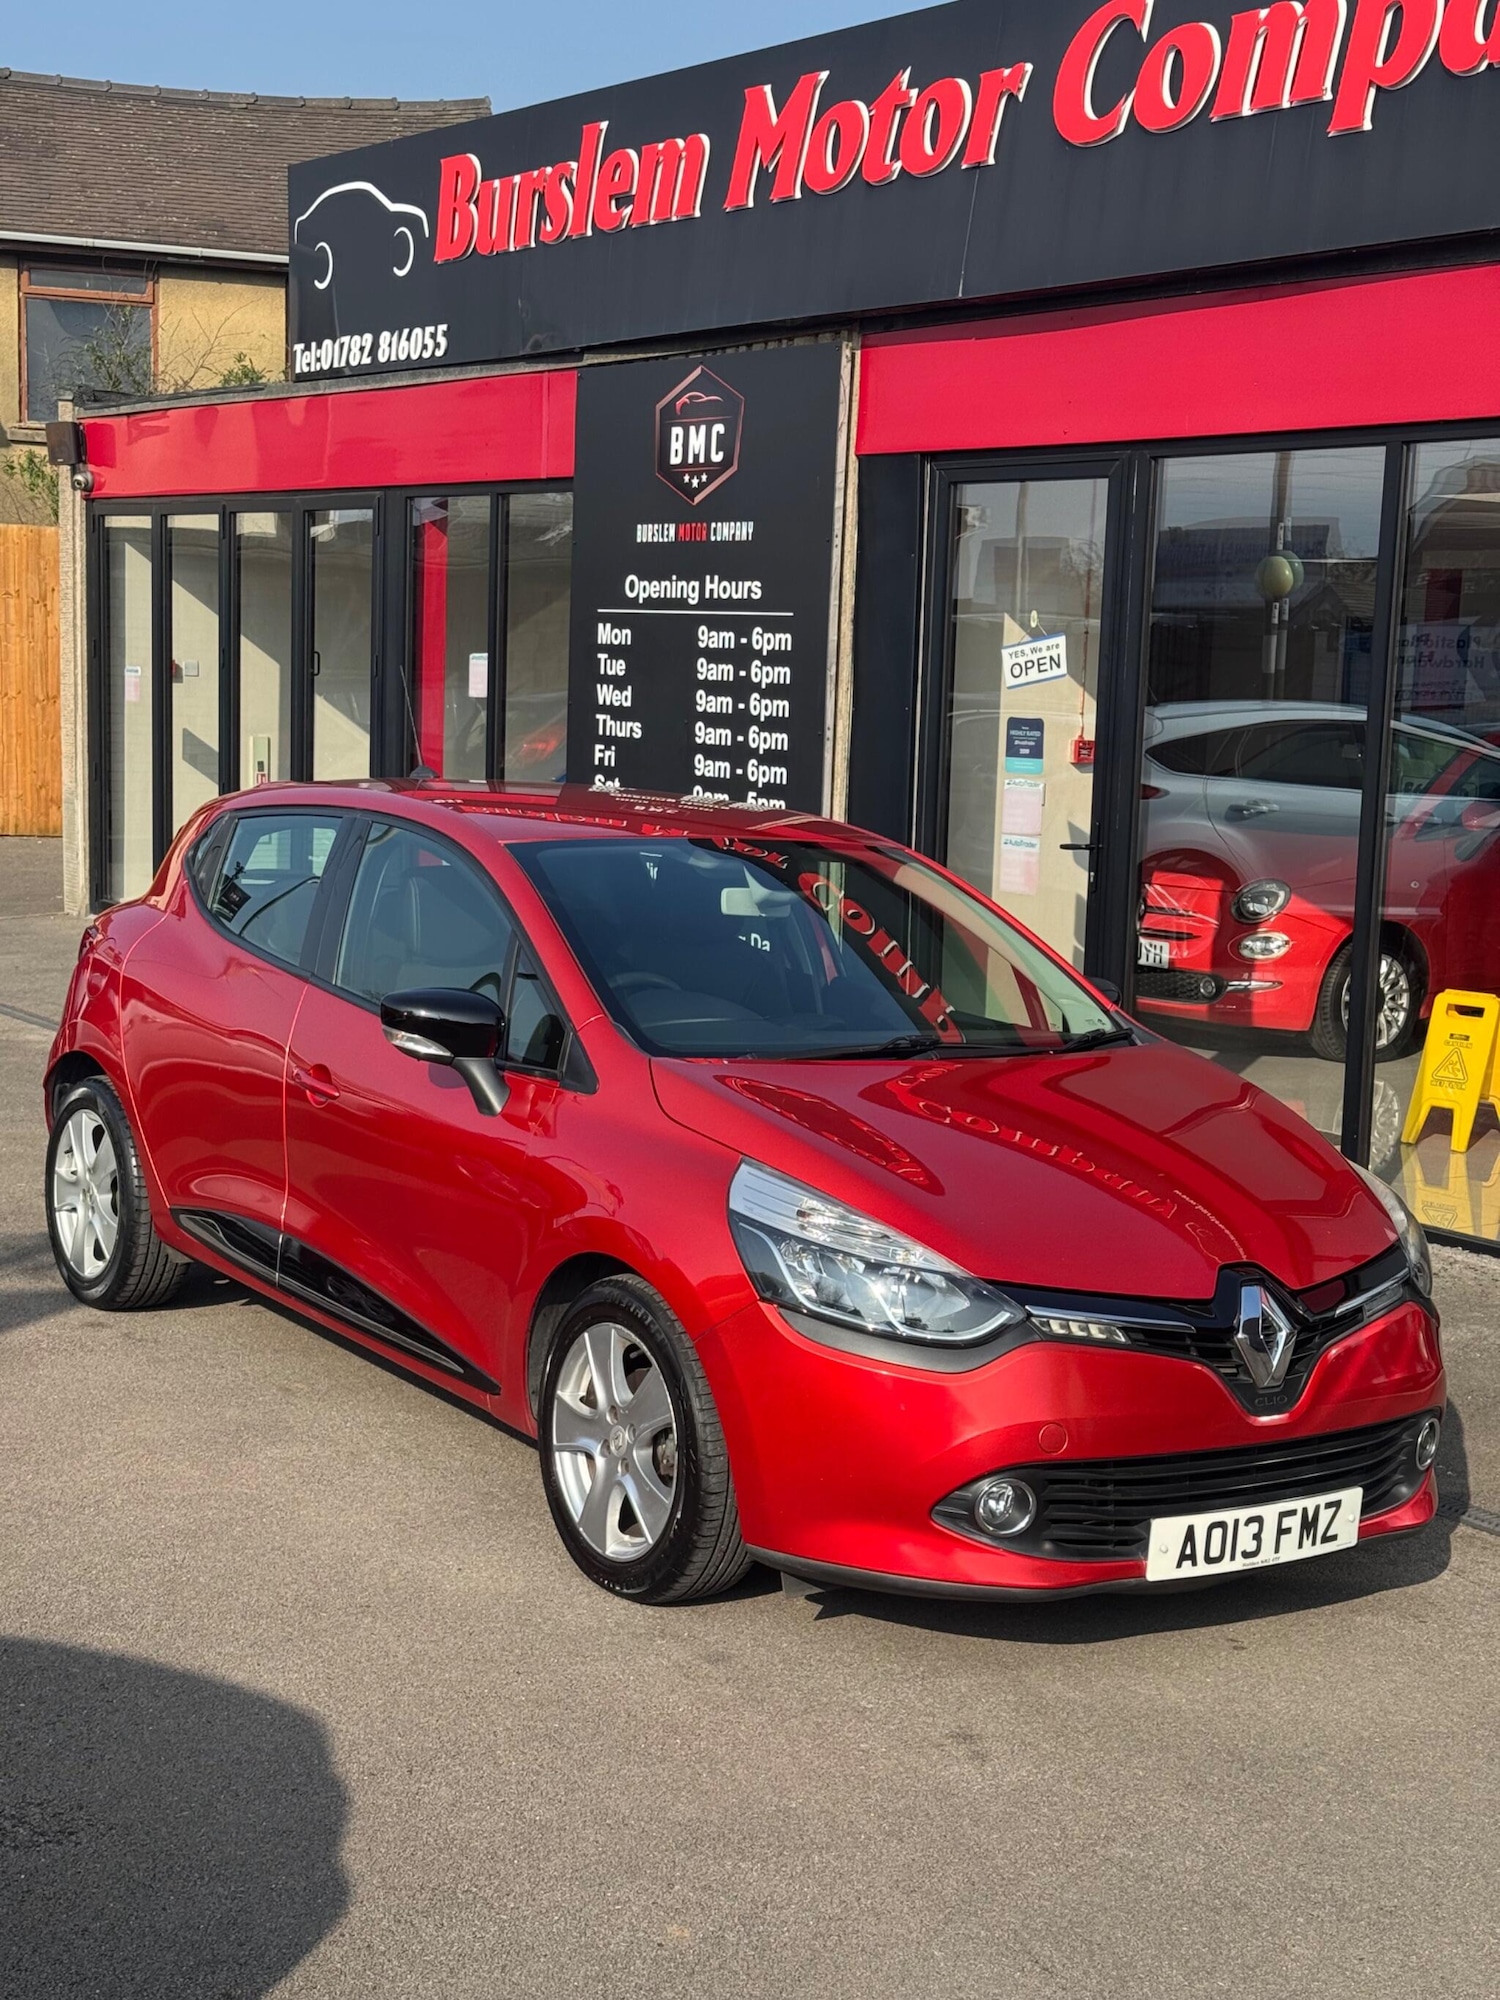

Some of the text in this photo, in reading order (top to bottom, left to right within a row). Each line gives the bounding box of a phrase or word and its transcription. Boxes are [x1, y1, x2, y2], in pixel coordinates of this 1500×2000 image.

[434, 121, 711, 264] Burslem
[723, 63, 1033, 211] Motor
[293, 323, 448, 374] Tel:01782 816055
[669, 423, 725, 466] BMC
[636, 521, 754, 543] BURSLEM MOTOR COMPANY
[624, 574, 763, 605] Opening Hours
[597, 623, 632, 646] Mon
[697, 625, 735, 649] 9am
[751, 627, 792, 656] 6pm
[1008, 643, 1060, 660] YES, We are
[597, 653, 626, 676] Tue
[696, 657, 734, 682] 9am
[750, 660, 791, 689] 6pm
[1010, 652, 1061, 679] OPEN
[596, 684, 632, 707] Wed
[695, 689, 733, 714] 9am
[749, 692, 790, 722] 6pm
[596, 714, 642, 739] Thurs
[694, 721, 732, 747] 9am
[748, 725, 789, 754] 6pm
[594, 743, 616, 767] Fri
[694, 753, 731, 779] 9am
[747, 758, 788, 788] 6pm
[1254, 1394, 1288, 1407] CLIO
[1175, 1499, 1342, 1569] AO13 FMZ
